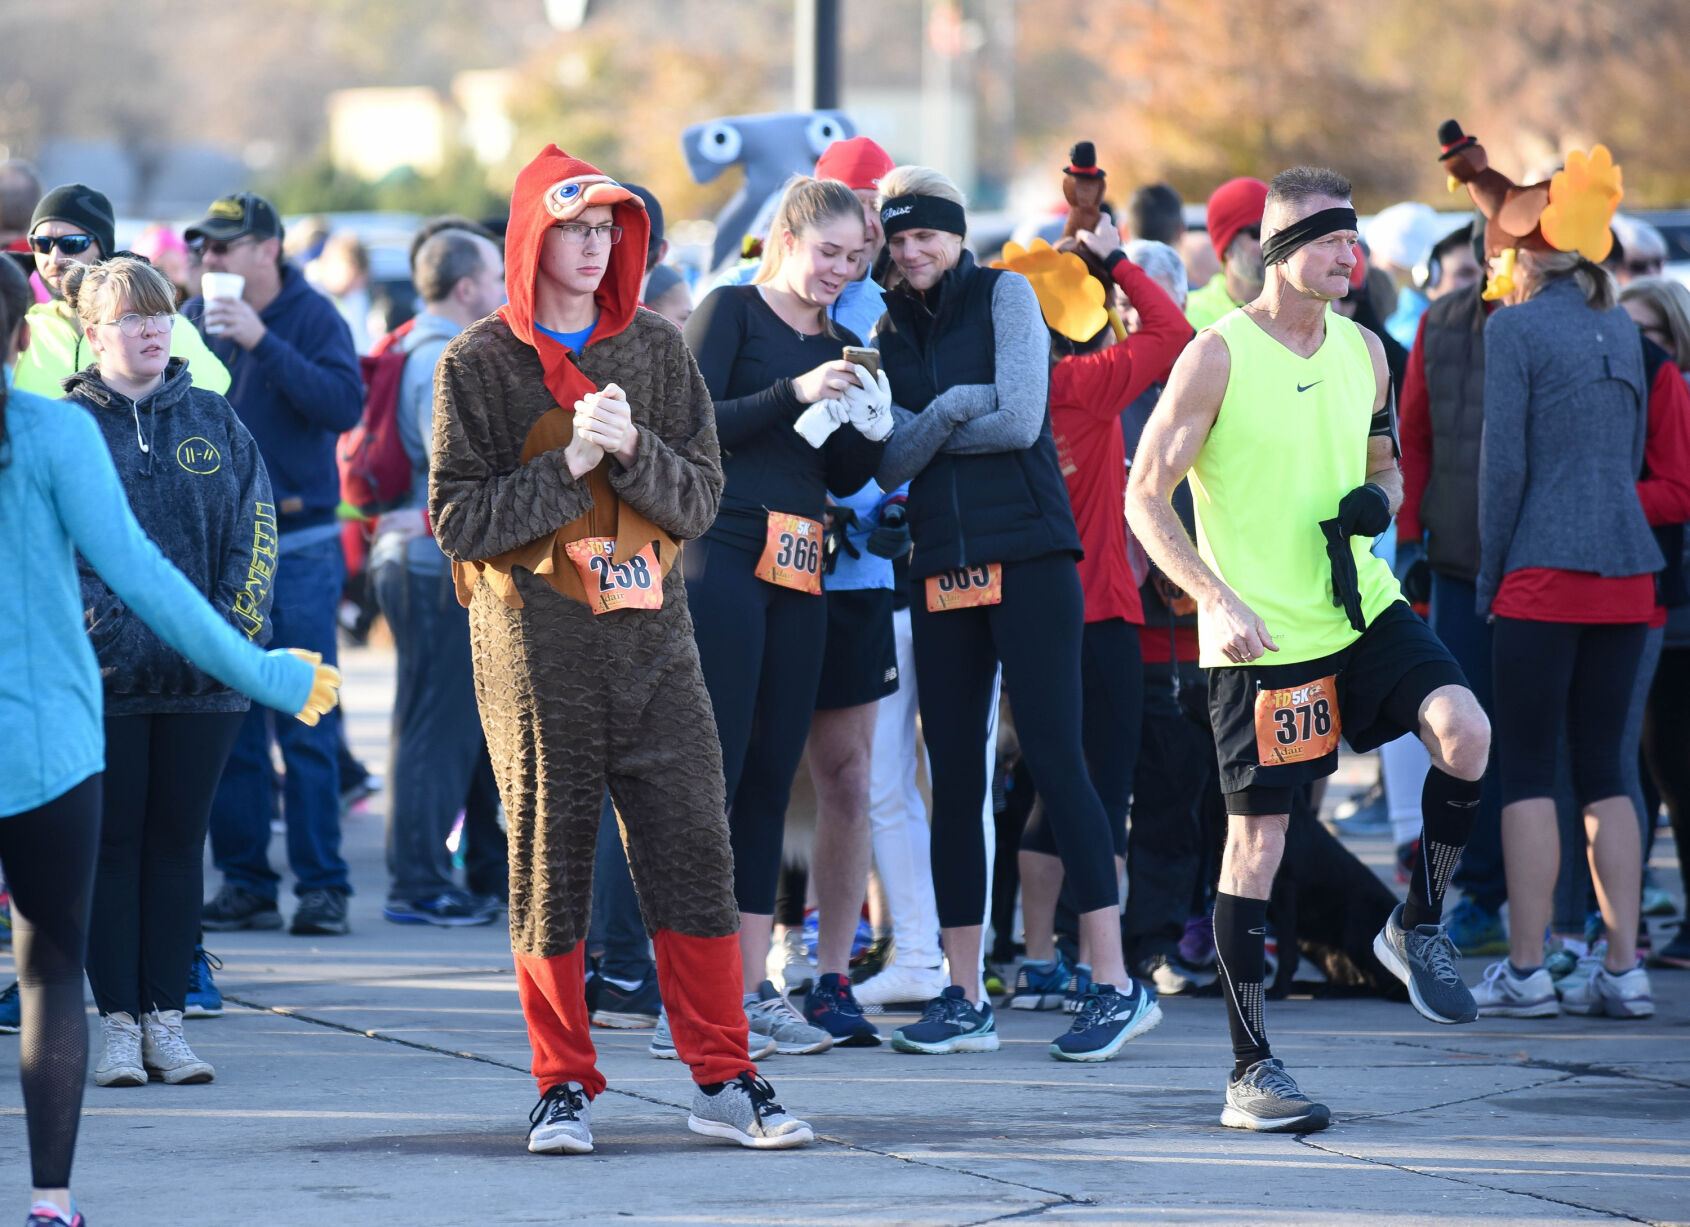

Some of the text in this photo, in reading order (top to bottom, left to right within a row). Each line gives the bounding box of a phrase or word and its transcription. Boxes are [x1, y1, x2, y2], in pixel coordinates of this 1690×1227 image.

[588, 554, 651, 592] 258
[776, 531, 819, 576] 366
[1273, 697, 1332, 747] 378
[1270, 744, 1304, 763] Adair
